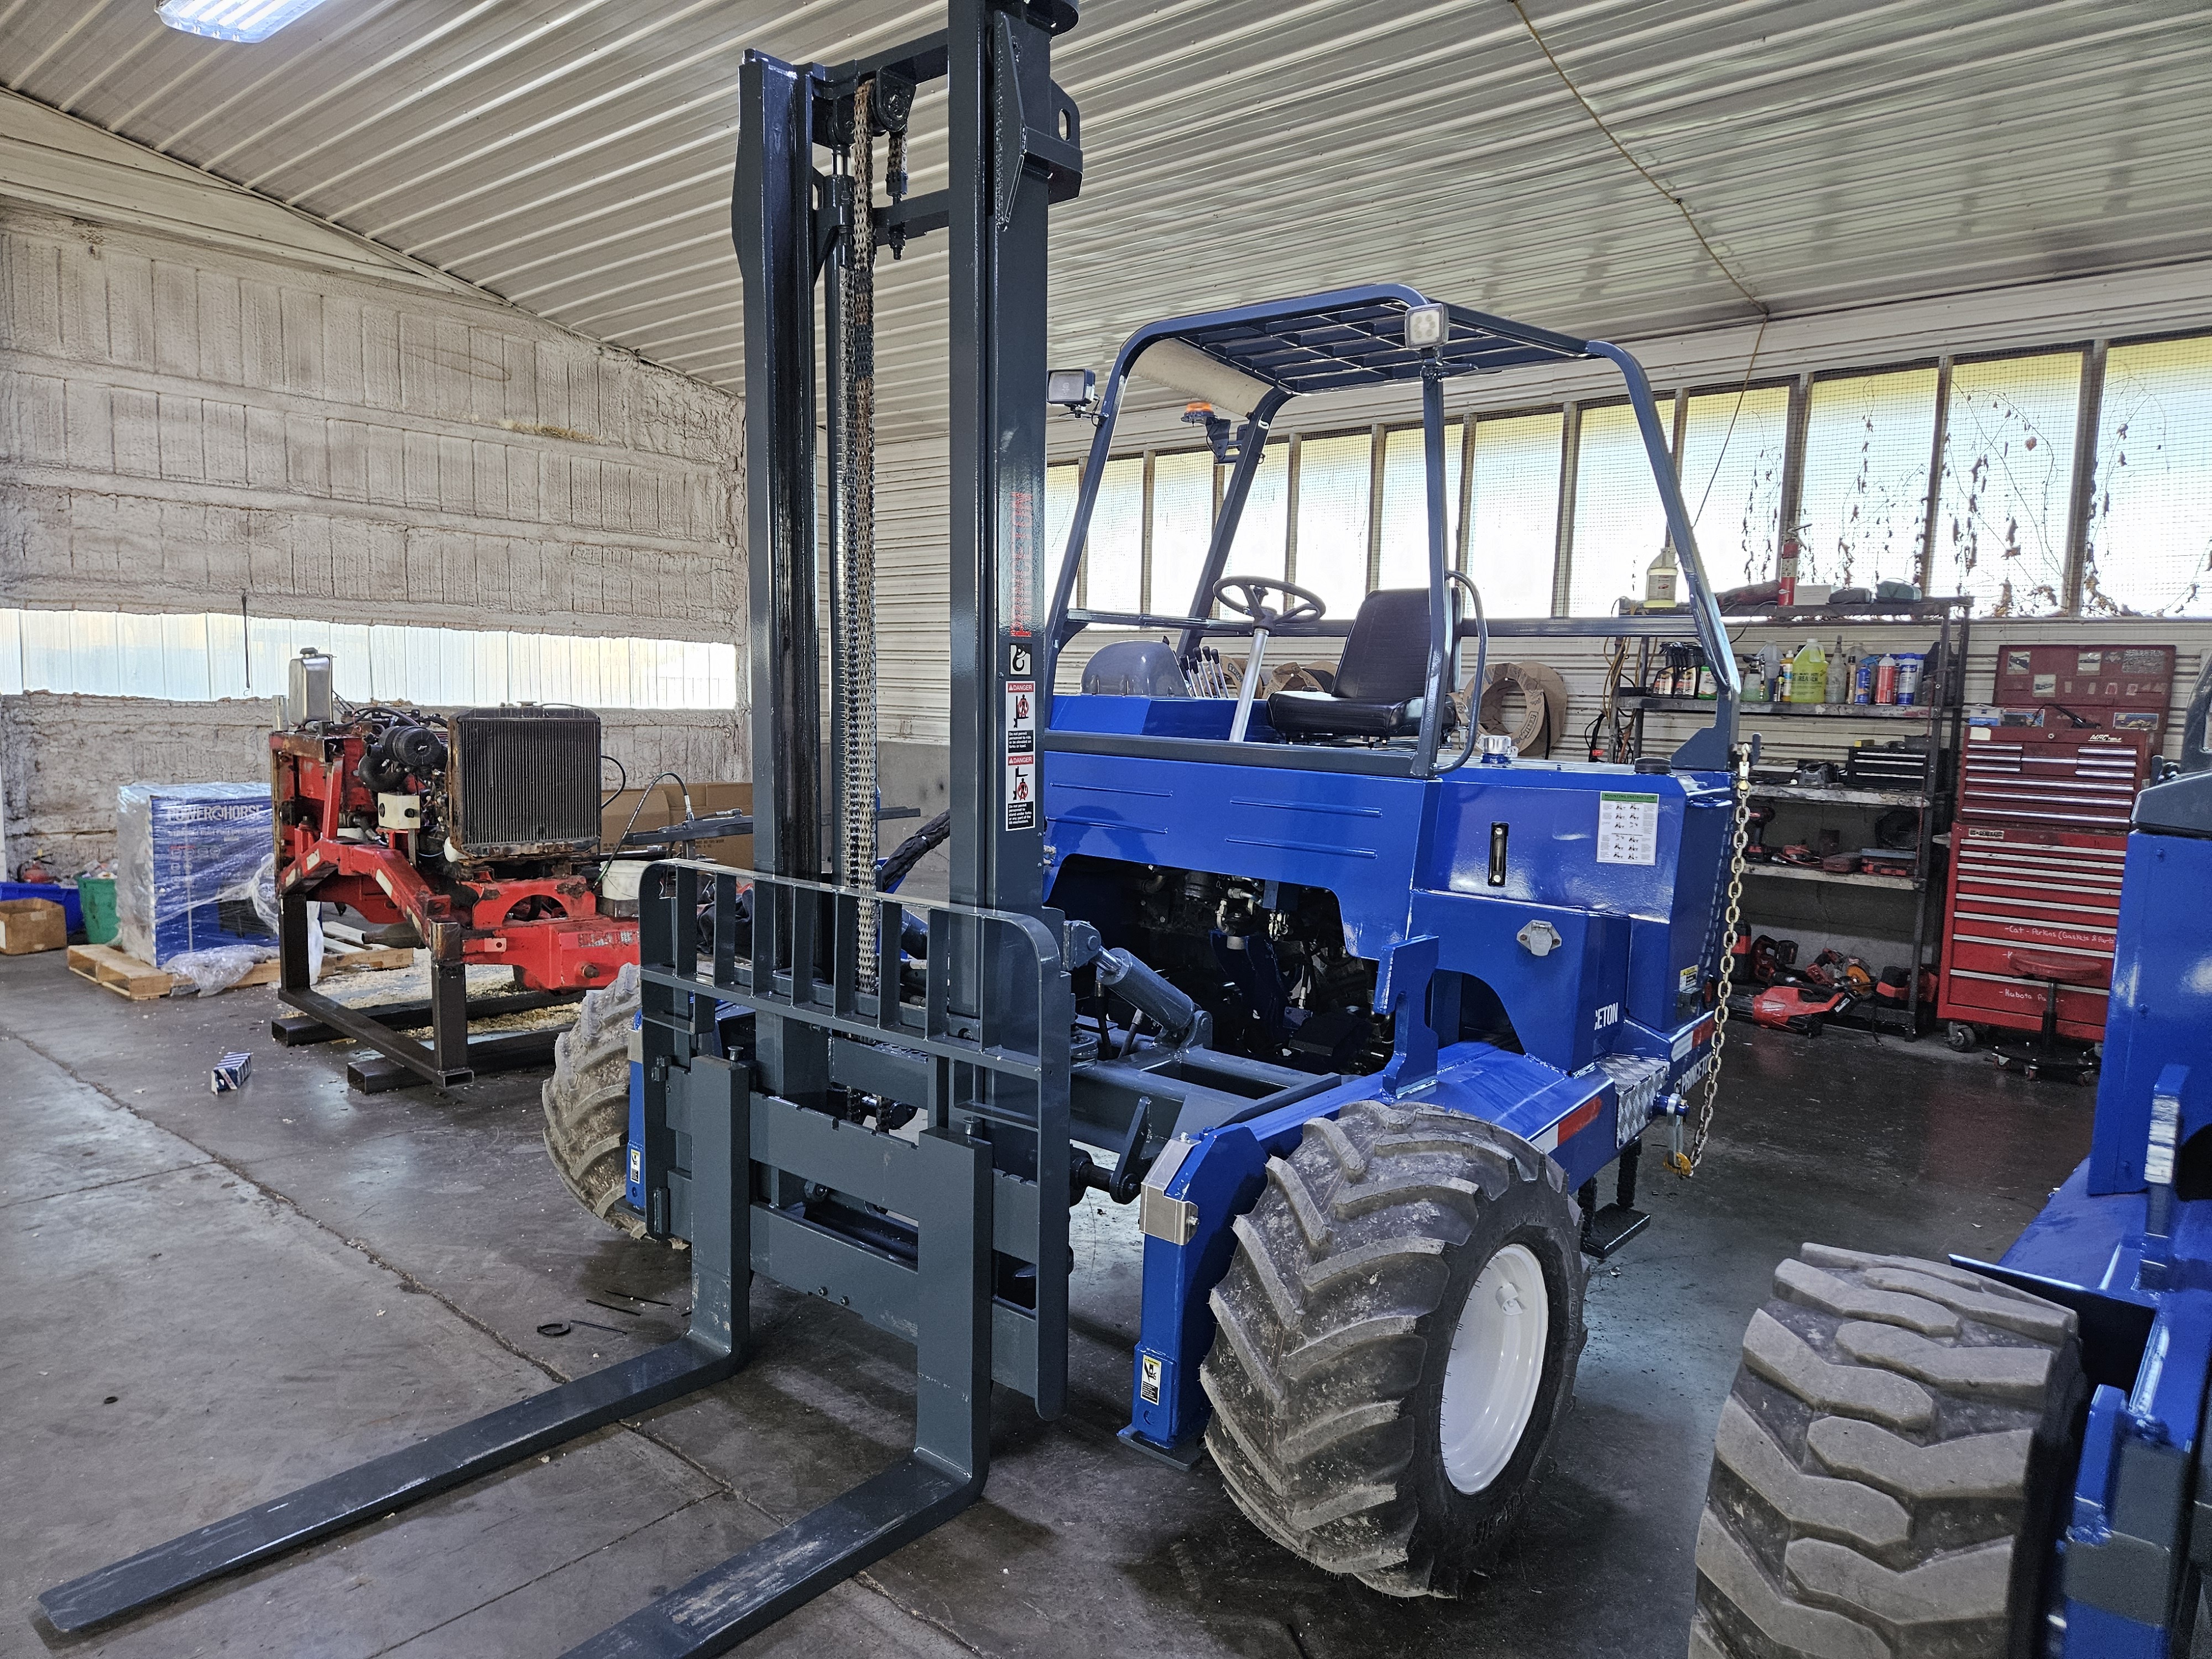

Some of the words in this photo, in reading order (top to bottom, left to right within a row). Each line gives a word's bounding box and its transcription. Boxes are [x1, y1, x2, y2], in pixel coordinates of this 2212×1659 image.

[1010, 491, 1033, 637] PRINCETON
[168, 806, 212, 822] POWER
[224, 805, 264, 820] HORSE
[2032, 927, 2057, 937] Perkins
[1681, 1051, 1713, 1095] PRINCETO
